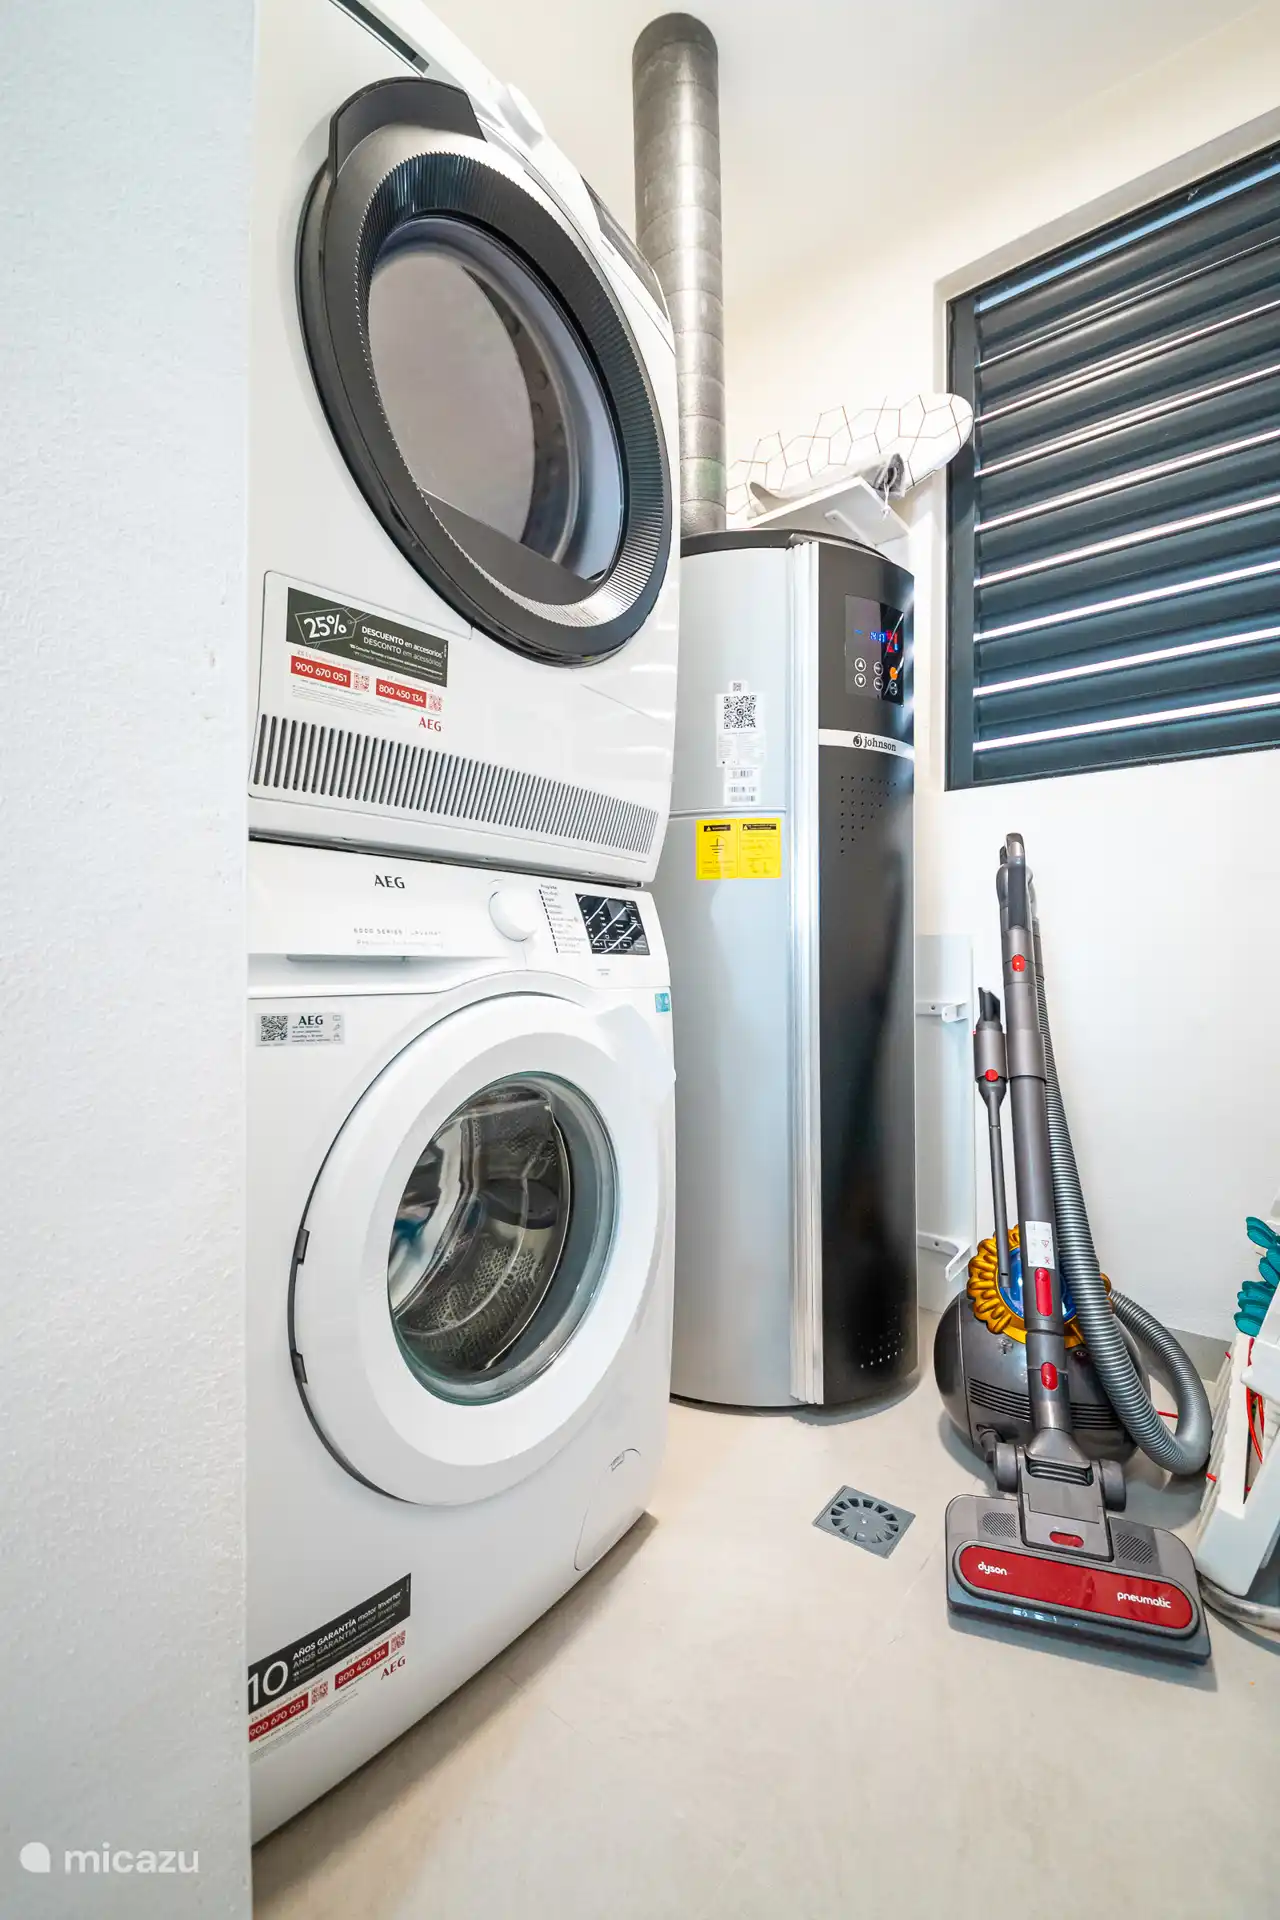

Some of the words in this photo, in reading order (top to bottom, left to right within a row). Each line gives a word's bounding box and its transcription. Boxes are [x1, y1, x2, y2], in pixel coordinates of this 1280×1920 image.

[303, 614, 347, 639] 25%
[361, 625, 404, 646] DESCUENTO
[404, 640, 413, 648] en
[363, 636, 402, 655] DESCONTO
[295, 661, 314, 674] 900
[315, 667, 331, 678] 670
[333, 671, 347, 683] 051
[378, 683, 395, 696] 800
[396, 689, 410, 700] 450
[412, 692, 424, 704] 134
[418, 716, 442, 732] AEG
[862, 736, 897, 752] johnson
[374, 874, 405, 889] AEG
[298, 1014, 324, 1026] AEG
[977, 1561, 1008, 1576] dyson
[1117, 1591, 1172, 1609] pneumatic
[292, 1642, 316, 1661] AÑOS
[316, 1618, 357, 1646] GARANTÍA
[357, 1606, 377, 1622] motor
[338, 1668, 355, 1684] 800
[356, 1657, 372, 1671] 450
[373, 1649, 386, 1661] 134
[380, 1656, 406, 1681] AEG
[248, 1660, 289, 1706] 10
[249, 1721, 269, 1738] 900
[271, 1710, 288, 1726] 670
[289, 1699, 305, 1715] 051
